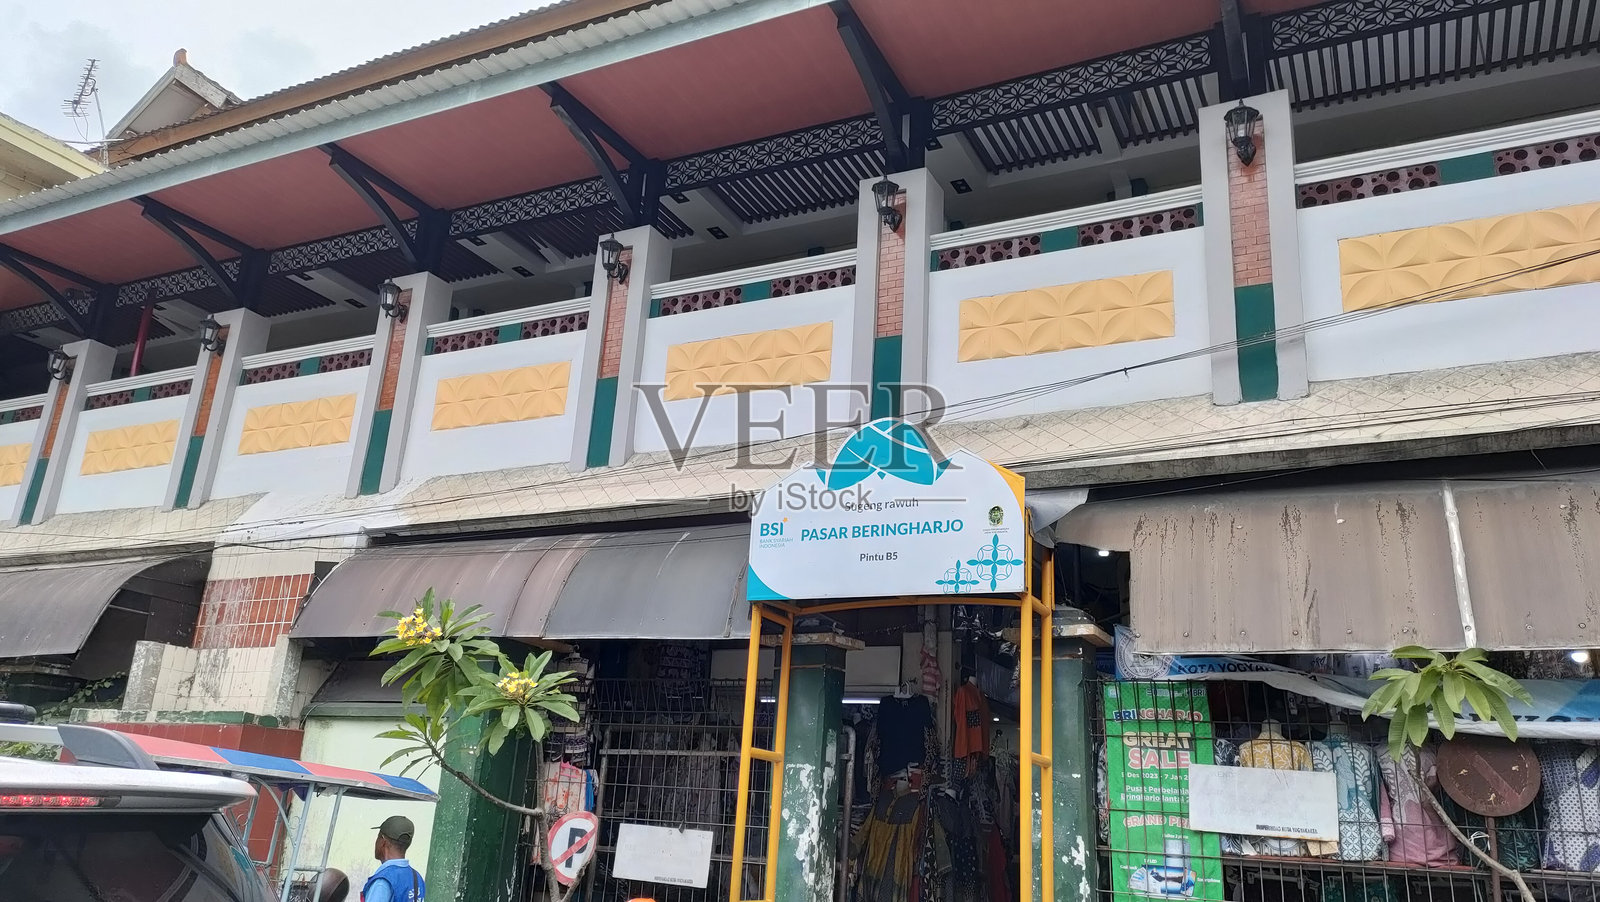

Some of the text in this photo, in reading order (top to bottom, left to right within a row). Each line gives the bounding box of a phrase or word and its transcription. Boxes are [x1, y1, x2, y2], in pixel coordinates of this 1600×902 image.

[845, 497, 919, 513] Sugeng rawuh
[760, 521, 784, 536] BSI
[800, 519, 964, 541] PASAR BERINGHARJO
[859, 551, 898, 562] Pintu B5
[1178, 663, 1215, 675] KOTA
[1123, 731, 1192, 750] GREAT
[1128, 748, 1190, 769] SALE
[1123, 814, 1167, 828] GRAND
[565, 827, 589, 869] P
